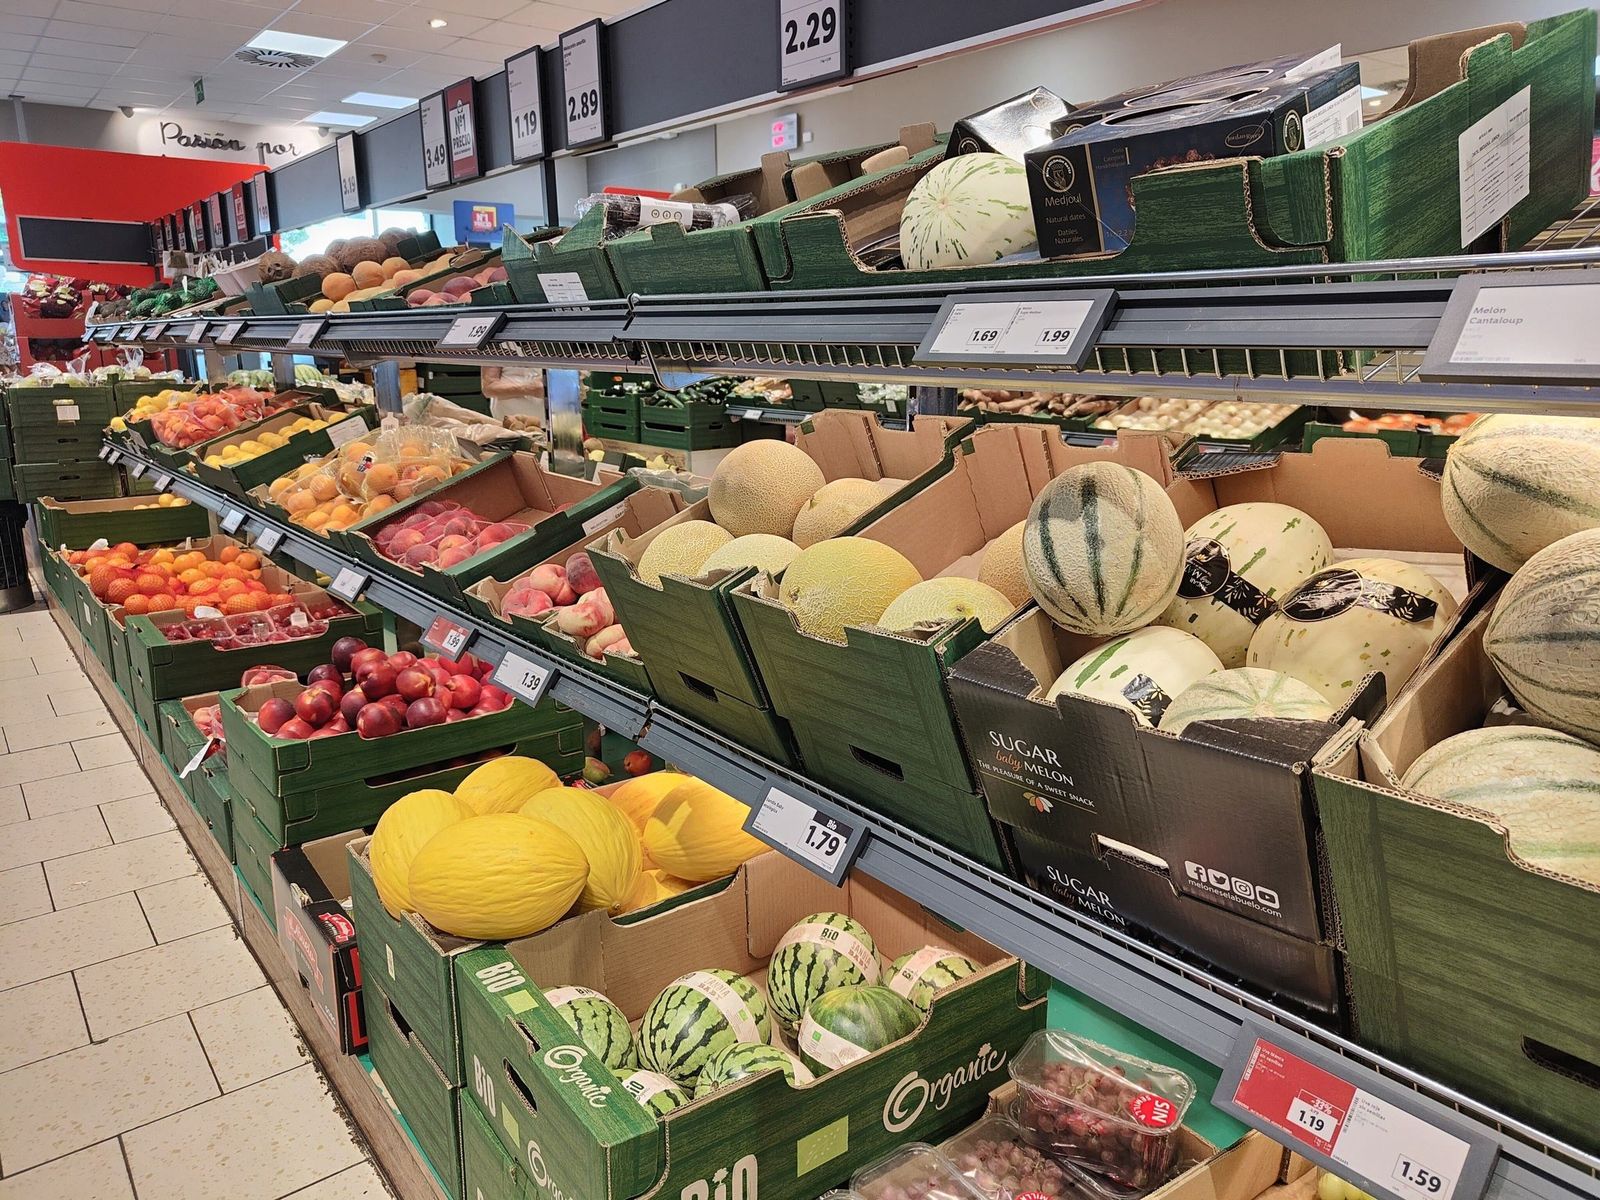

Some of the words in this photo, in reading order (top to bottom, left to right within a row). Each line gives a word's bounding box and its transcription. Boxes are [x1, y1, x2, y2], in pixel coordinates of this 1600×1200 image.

[785, 7, 836, 55] 2.29
[568, 89, 598, 122] 2.89
[515, 110, 537, 138] 1.19
[257, 142, 301, 166] por
[453, 133, 471, 150] PRECIO
[426, 144, 445, 169] 3.49
[343, 176, 356, 195] 3.19
[1045, 193, 1082, 207] Medjoul
[1046, 215, 1069, 224] Natural
[468, 325, 487, 338] 1.99
[1469, 317, 1524, 326] Cantaloup
[972, 330, 998, 342] 1.69
[1042, 330, 1071, 342] 1.99
[521, 672, 541, 691] 1.39
[989, 730, 1063, 768] SUGAR
[995, 750, 1023, 772] baby
[1024, 761, 1075, 787] MELON
[977, 758, 992, 771] THE
[992, 765, 1025, 783] PLEASURE
[1025, 777, 1035, 788] OF
[1037, 782, 1044, 790] A
[1044, 784, 1068, 797] SWEET
[1069, 793, 1096, 808] SNACK
[805, 825, 840, 857] 1.79
[1046, 865, 1114, 910] SUGAR
[1188, 879, 1282, 919] meloneselabuelo.com
[1078, 898, 1126, 927] MELON
[544, 1045, 606, 1108] Organic
[882, 1043, 1007, 1133] Organic
[1152, 1100, 1170, 1124] SIN
[1311, 1099, 1333, 1115] -33%
[1298, 1110, 1324, 1131] 1.19
[1402, 1161, 1441, 1193] 1.59
